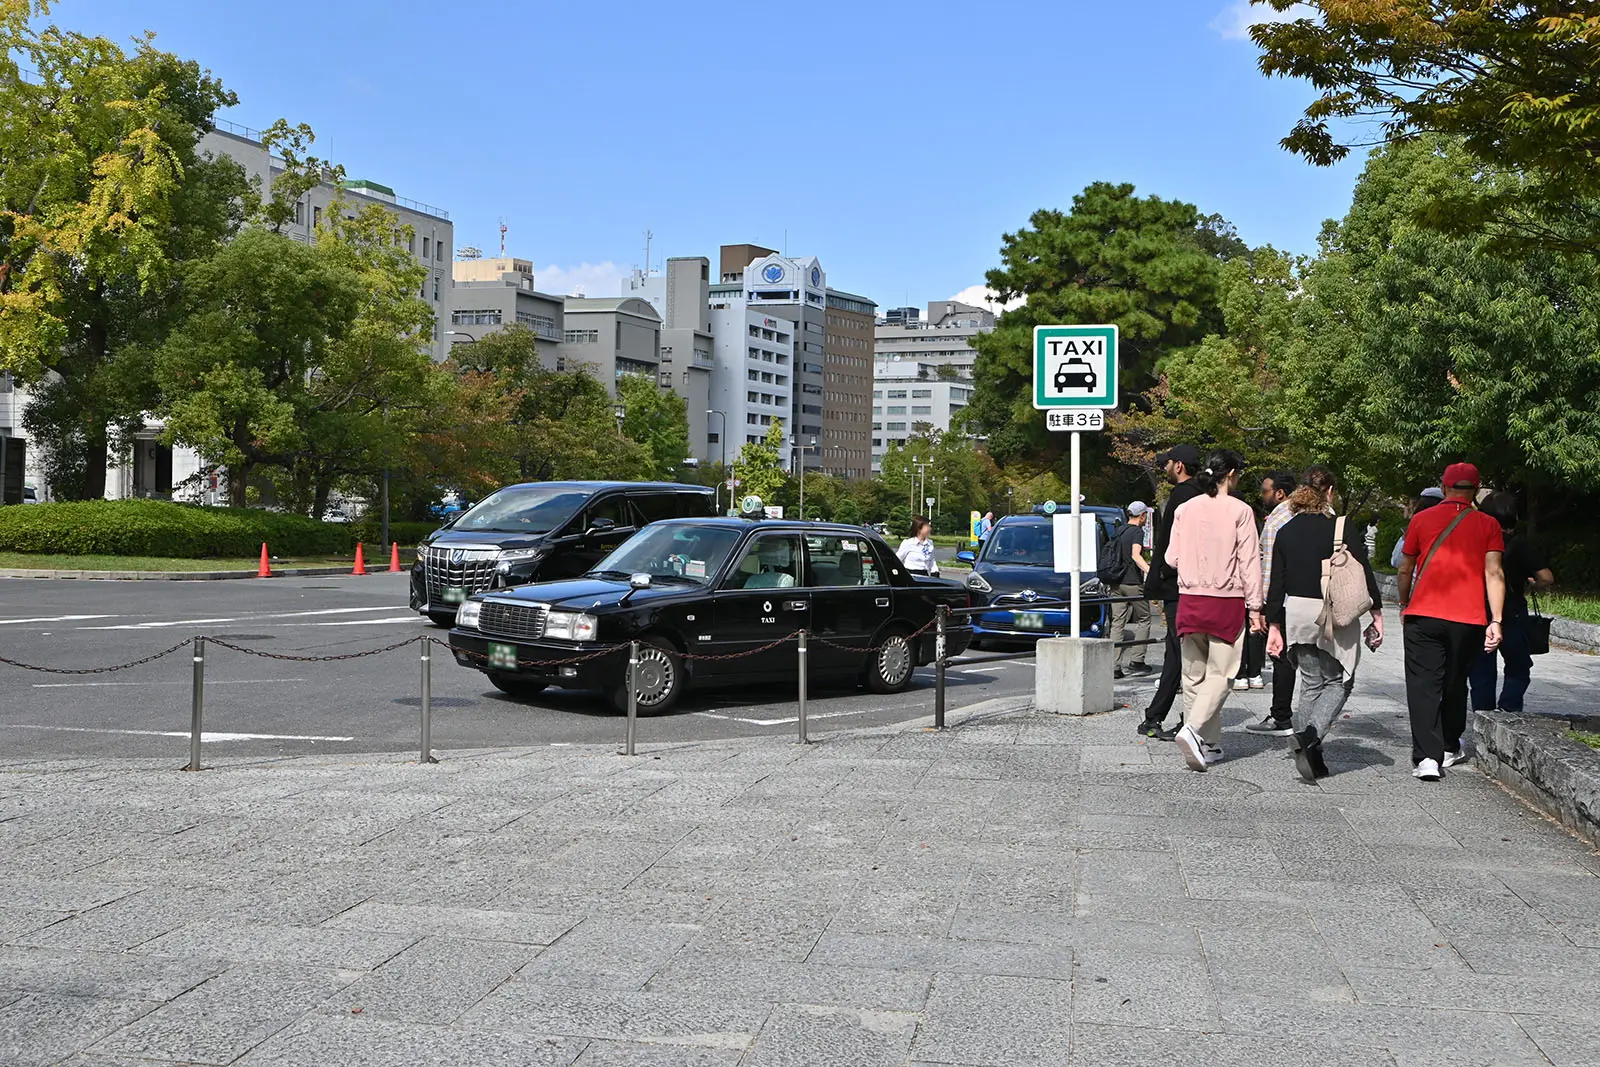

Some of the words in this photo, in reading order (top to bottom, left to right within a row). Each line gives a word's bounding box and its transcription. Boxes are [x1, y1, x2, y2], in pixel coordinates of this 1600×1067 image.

[1048, 341, 1102, 355] TAXI
[1049, 413, 1102, 427] 駐車3台
